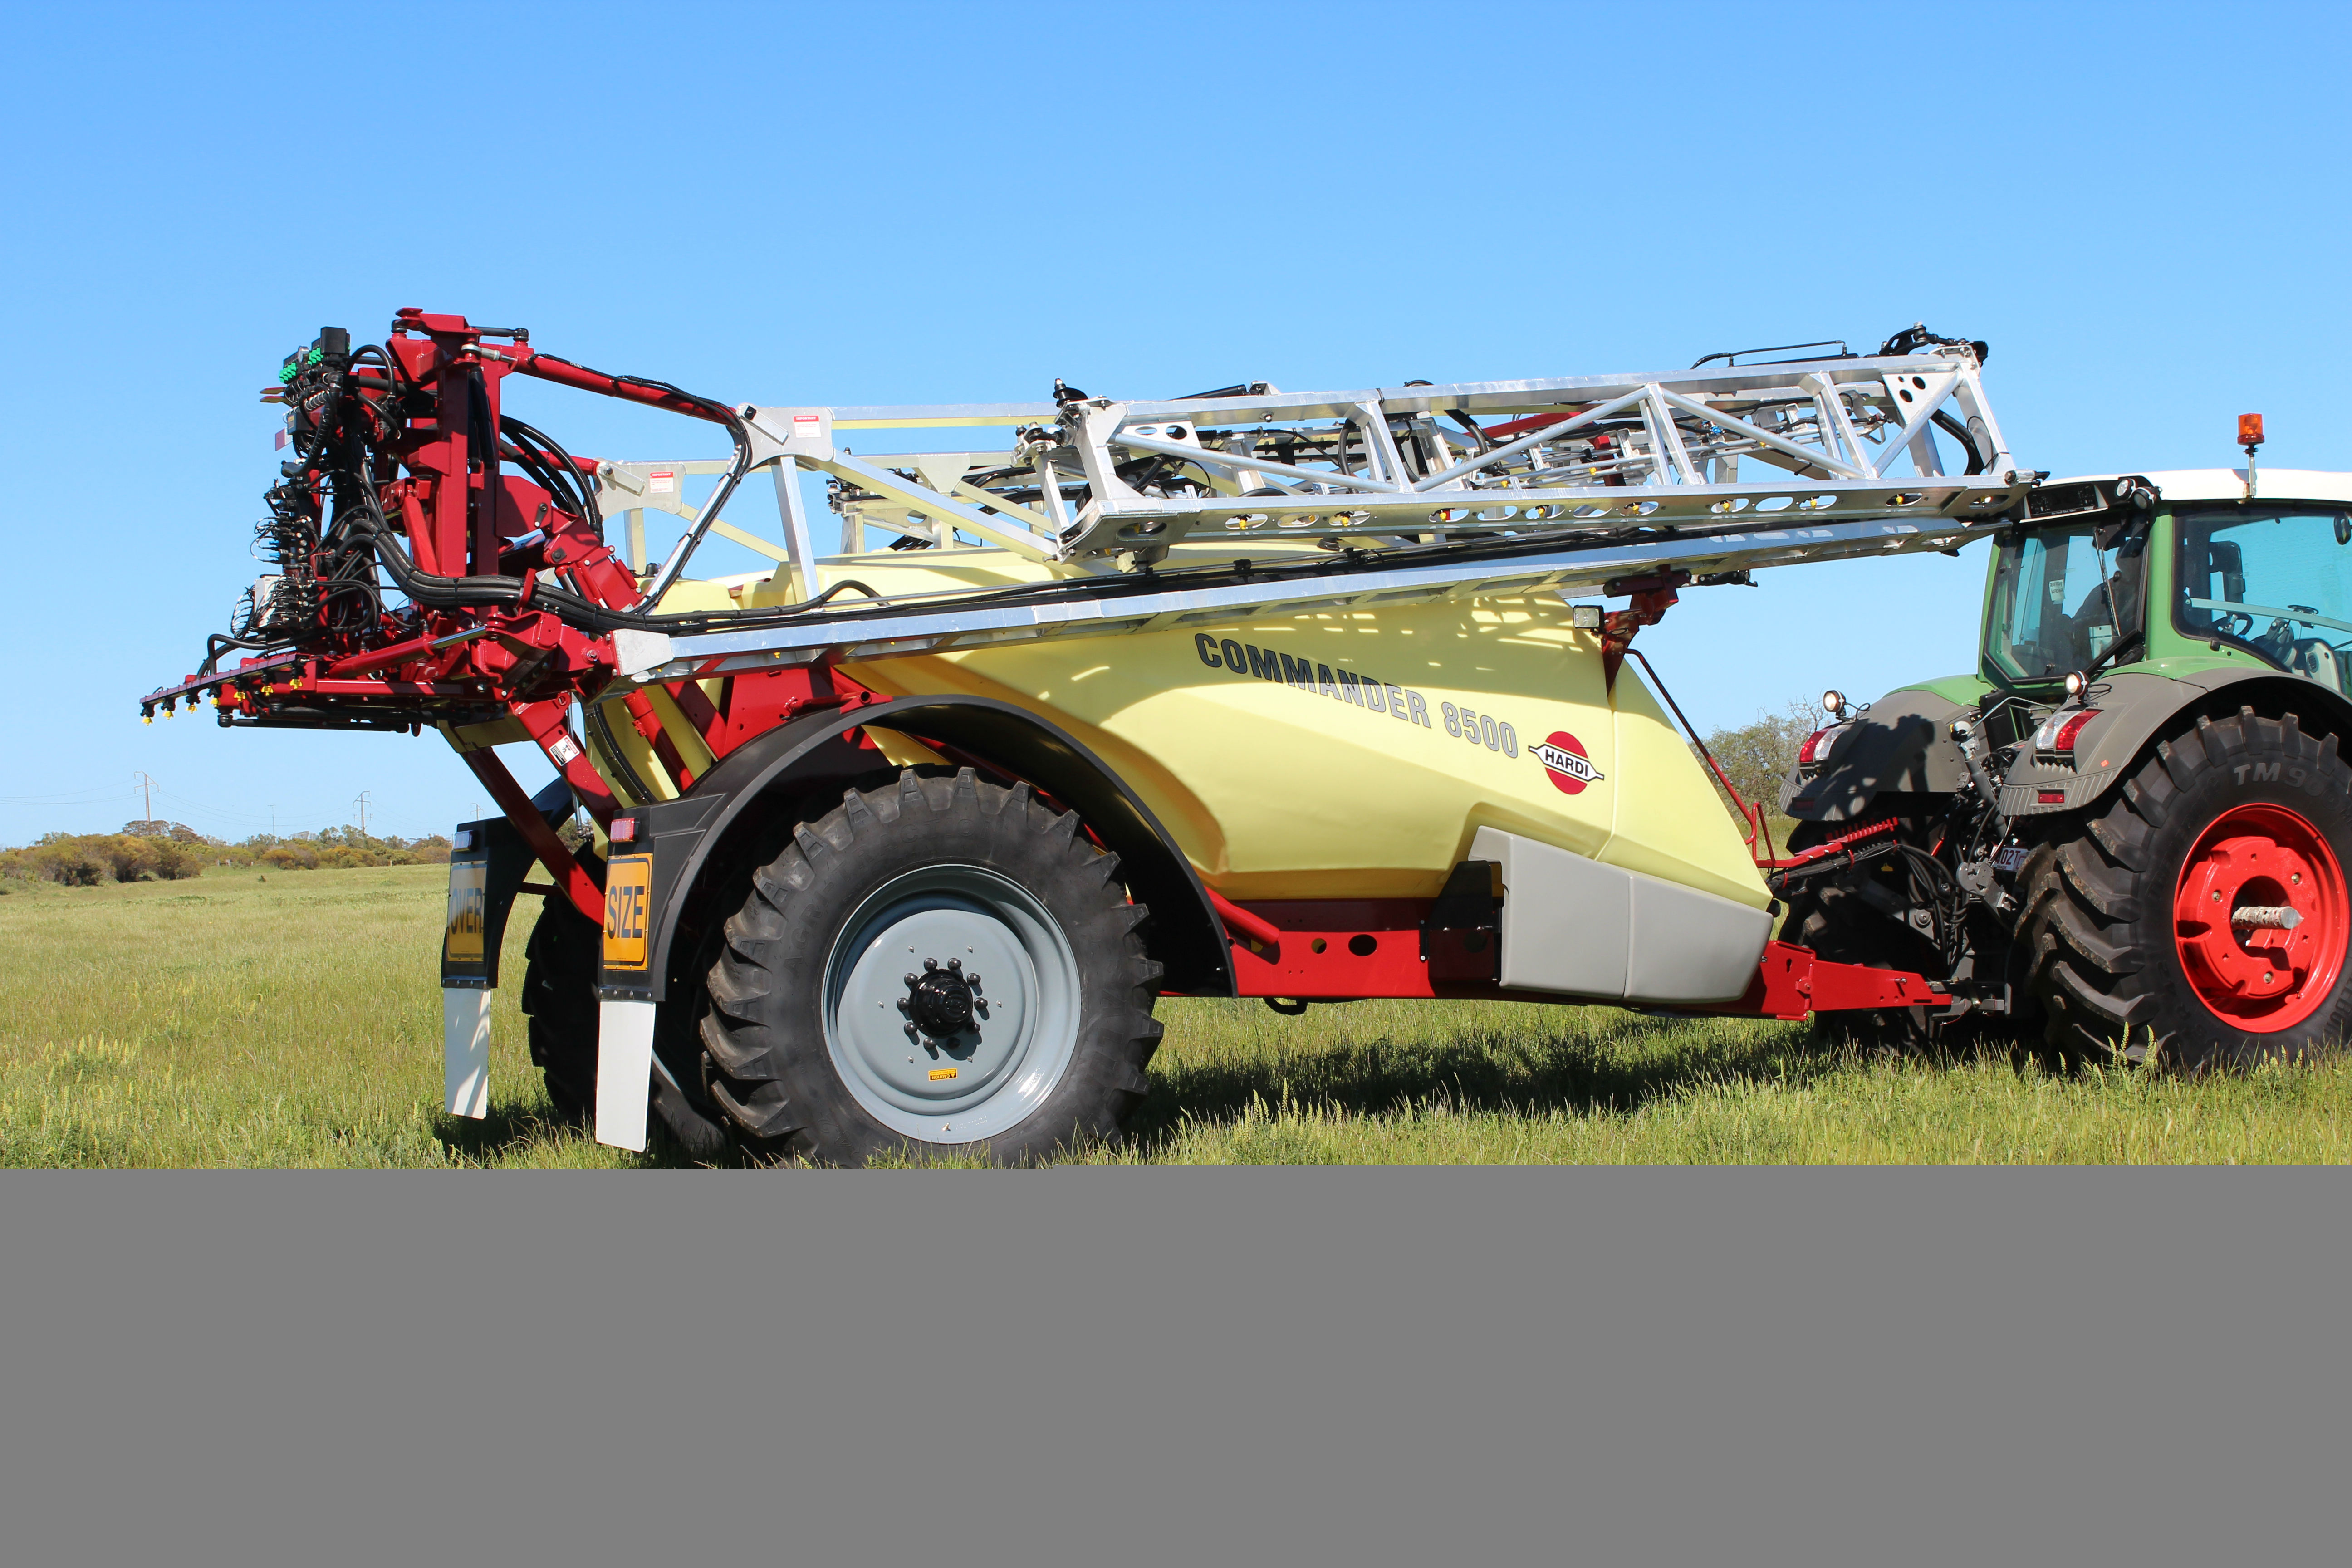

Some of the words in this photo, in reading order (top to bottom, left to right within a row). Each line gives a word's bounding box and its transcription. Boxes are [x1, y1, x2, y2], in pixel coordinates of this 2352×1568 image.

[1195, 633, 1431, 729] COMMANDER
[1441, 701, 1518, 759] 8500
[1545, 749, 1588, 777] HARDI
[451, 888, 483, 935] OVER
[607, 885, 645, 939] SIZE
